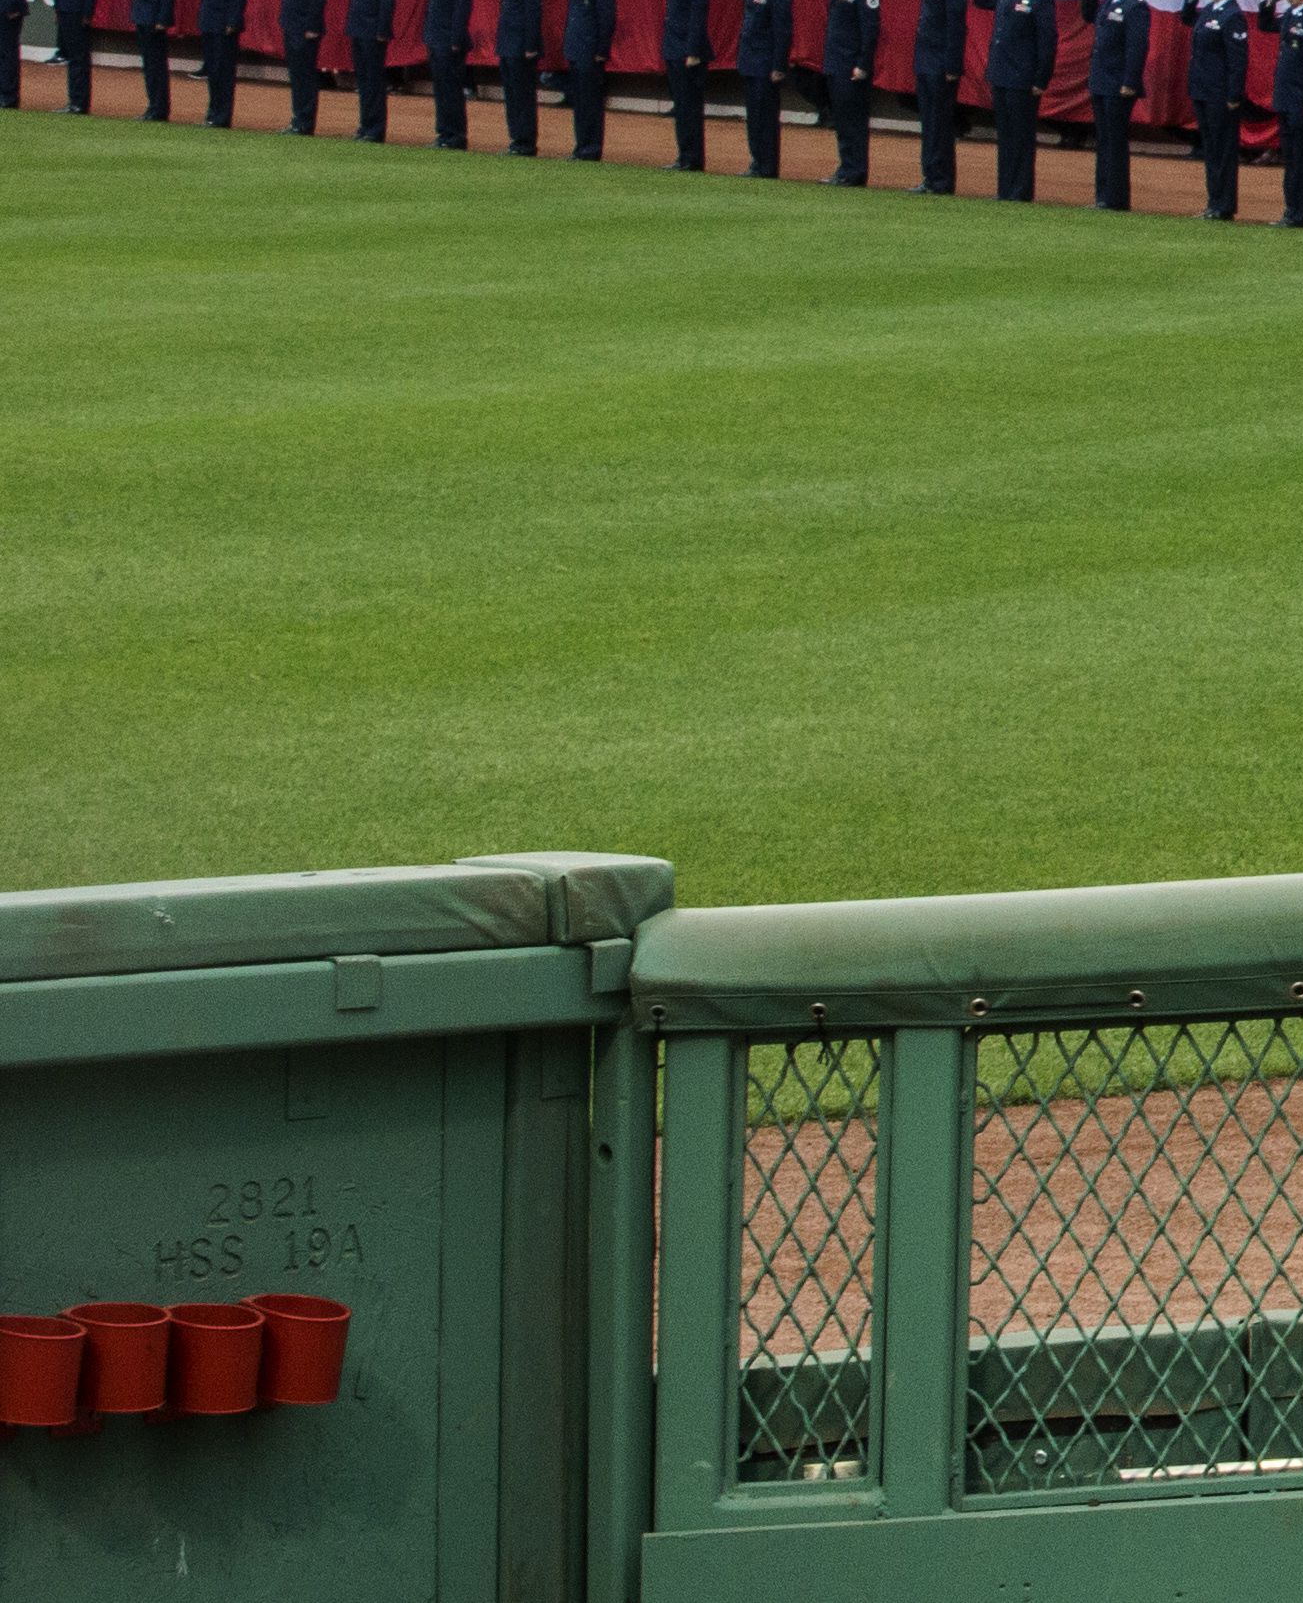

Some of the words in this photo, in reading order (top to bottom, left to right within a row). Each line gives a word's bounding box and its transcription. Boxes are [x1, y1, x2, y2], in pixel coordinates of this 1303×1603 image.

[207, 1175, 318, 1227] 2821
[155, 1234, 244, 1282] HSS
[283, 1224, 364, 1270] 19A
